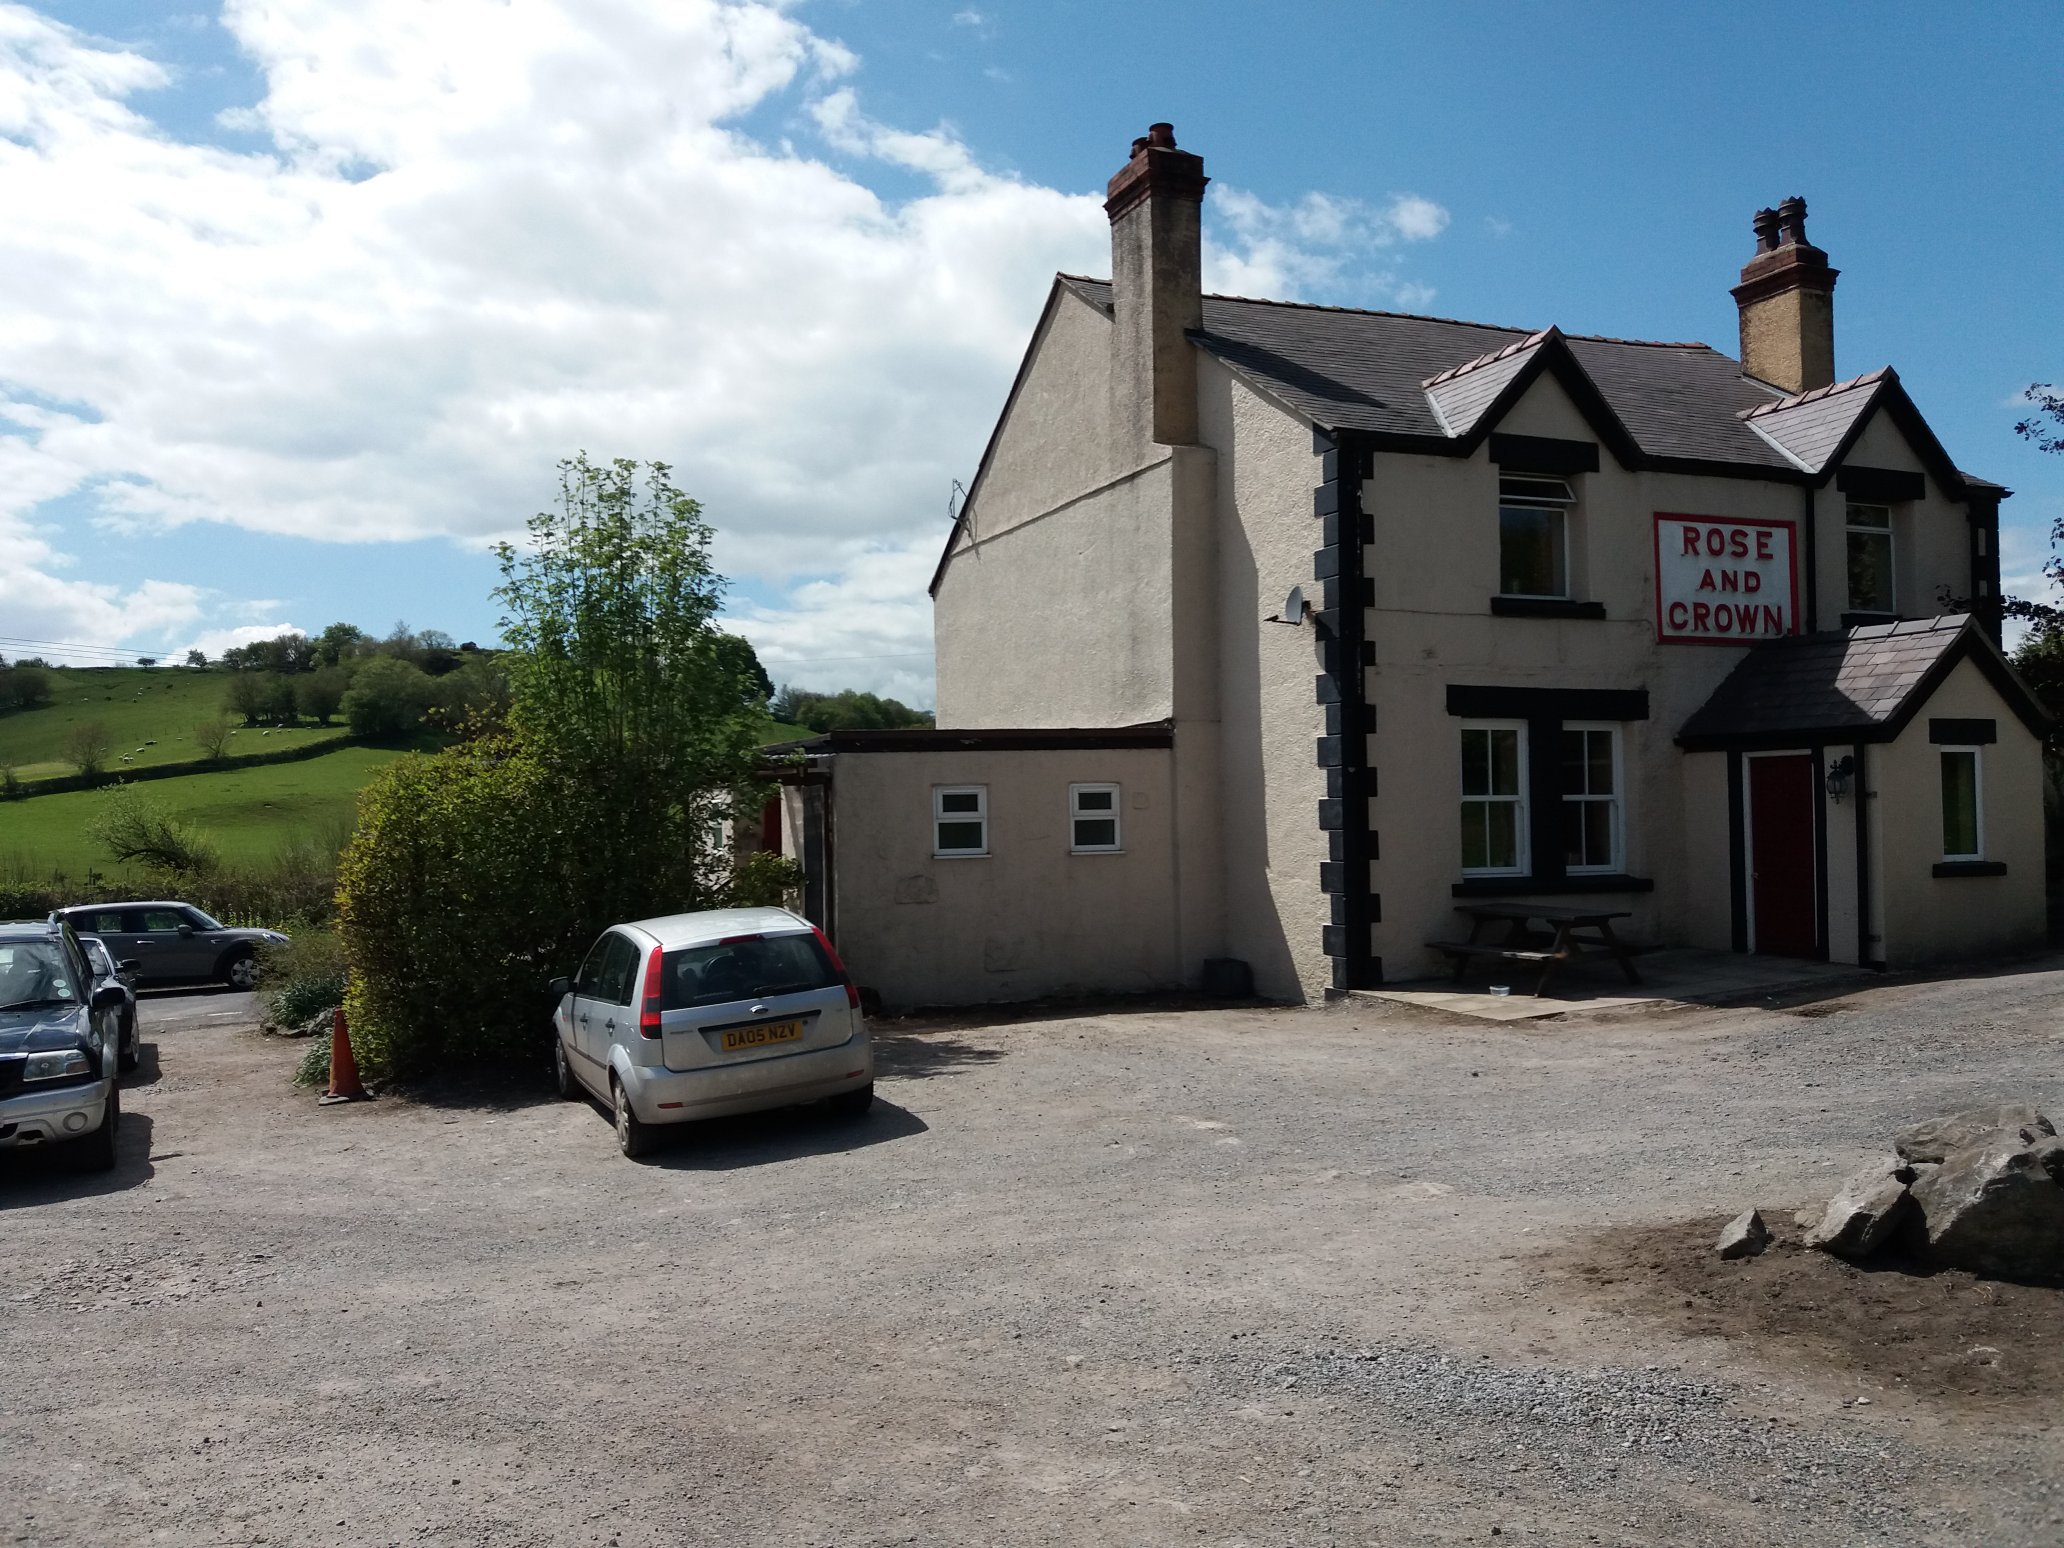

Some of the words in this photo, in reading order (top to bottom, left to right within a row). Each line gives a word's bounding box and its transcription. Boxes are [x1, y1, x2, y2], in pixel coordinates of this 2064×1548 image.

[1682, 526, 1773, 559] ROSE
[1698, 569, 1760, 592] AND
[1669, 602, 1782, 634] CROWN
[727, 1029, 765, 1046] DA05
[769, 1024, 795, 1040] NZV
